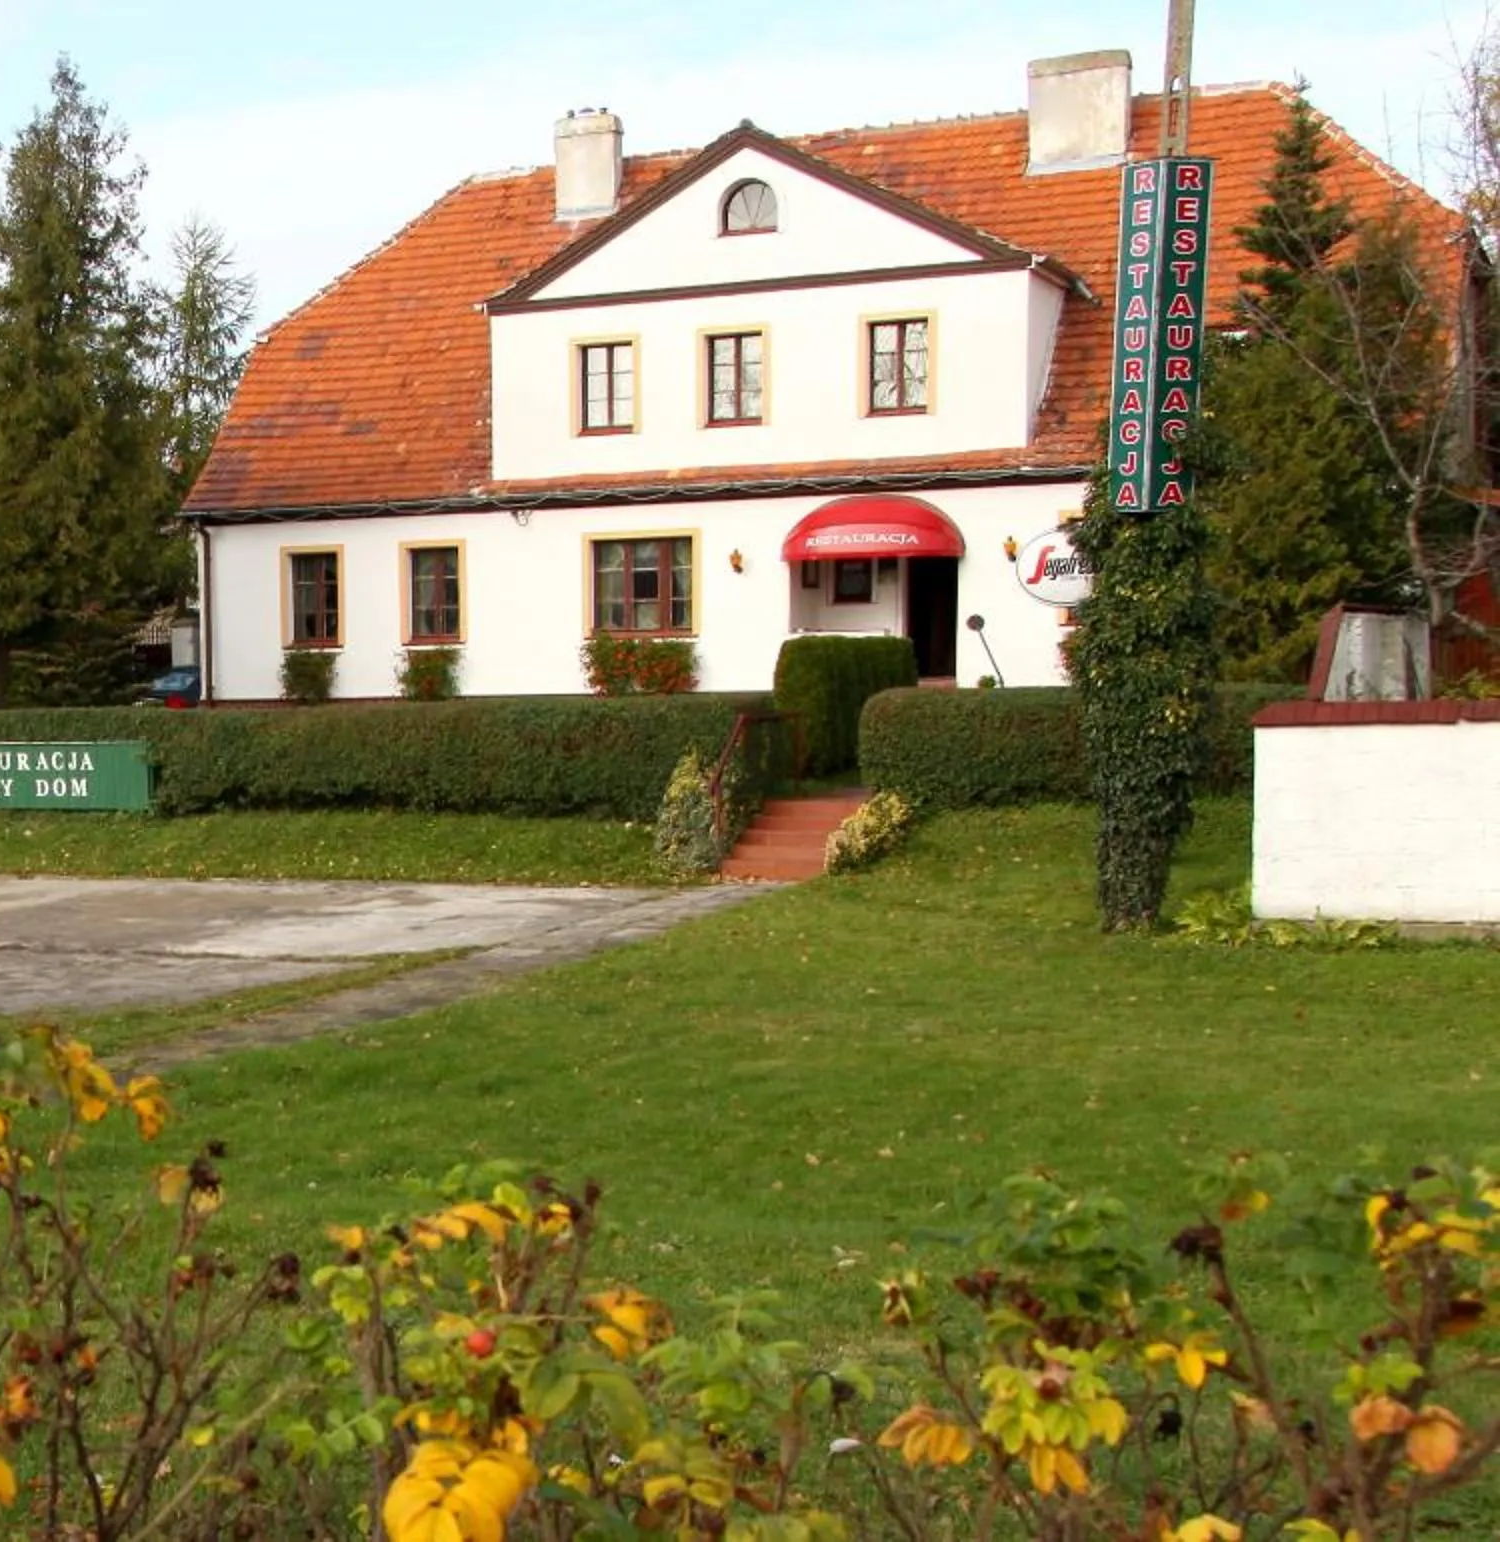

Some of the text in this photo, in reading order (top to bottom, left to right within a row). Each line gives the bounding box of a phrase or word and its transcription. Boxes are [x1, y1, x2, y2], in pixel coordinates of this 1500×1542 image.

[1116, 167, 1156, 508] RESTAURACJA
[1157, 165, 1202, 507] RESTAURACJA
[805, 533, 920, 548] RESTAURACJA
[35, 778, 89, 797] DOM
